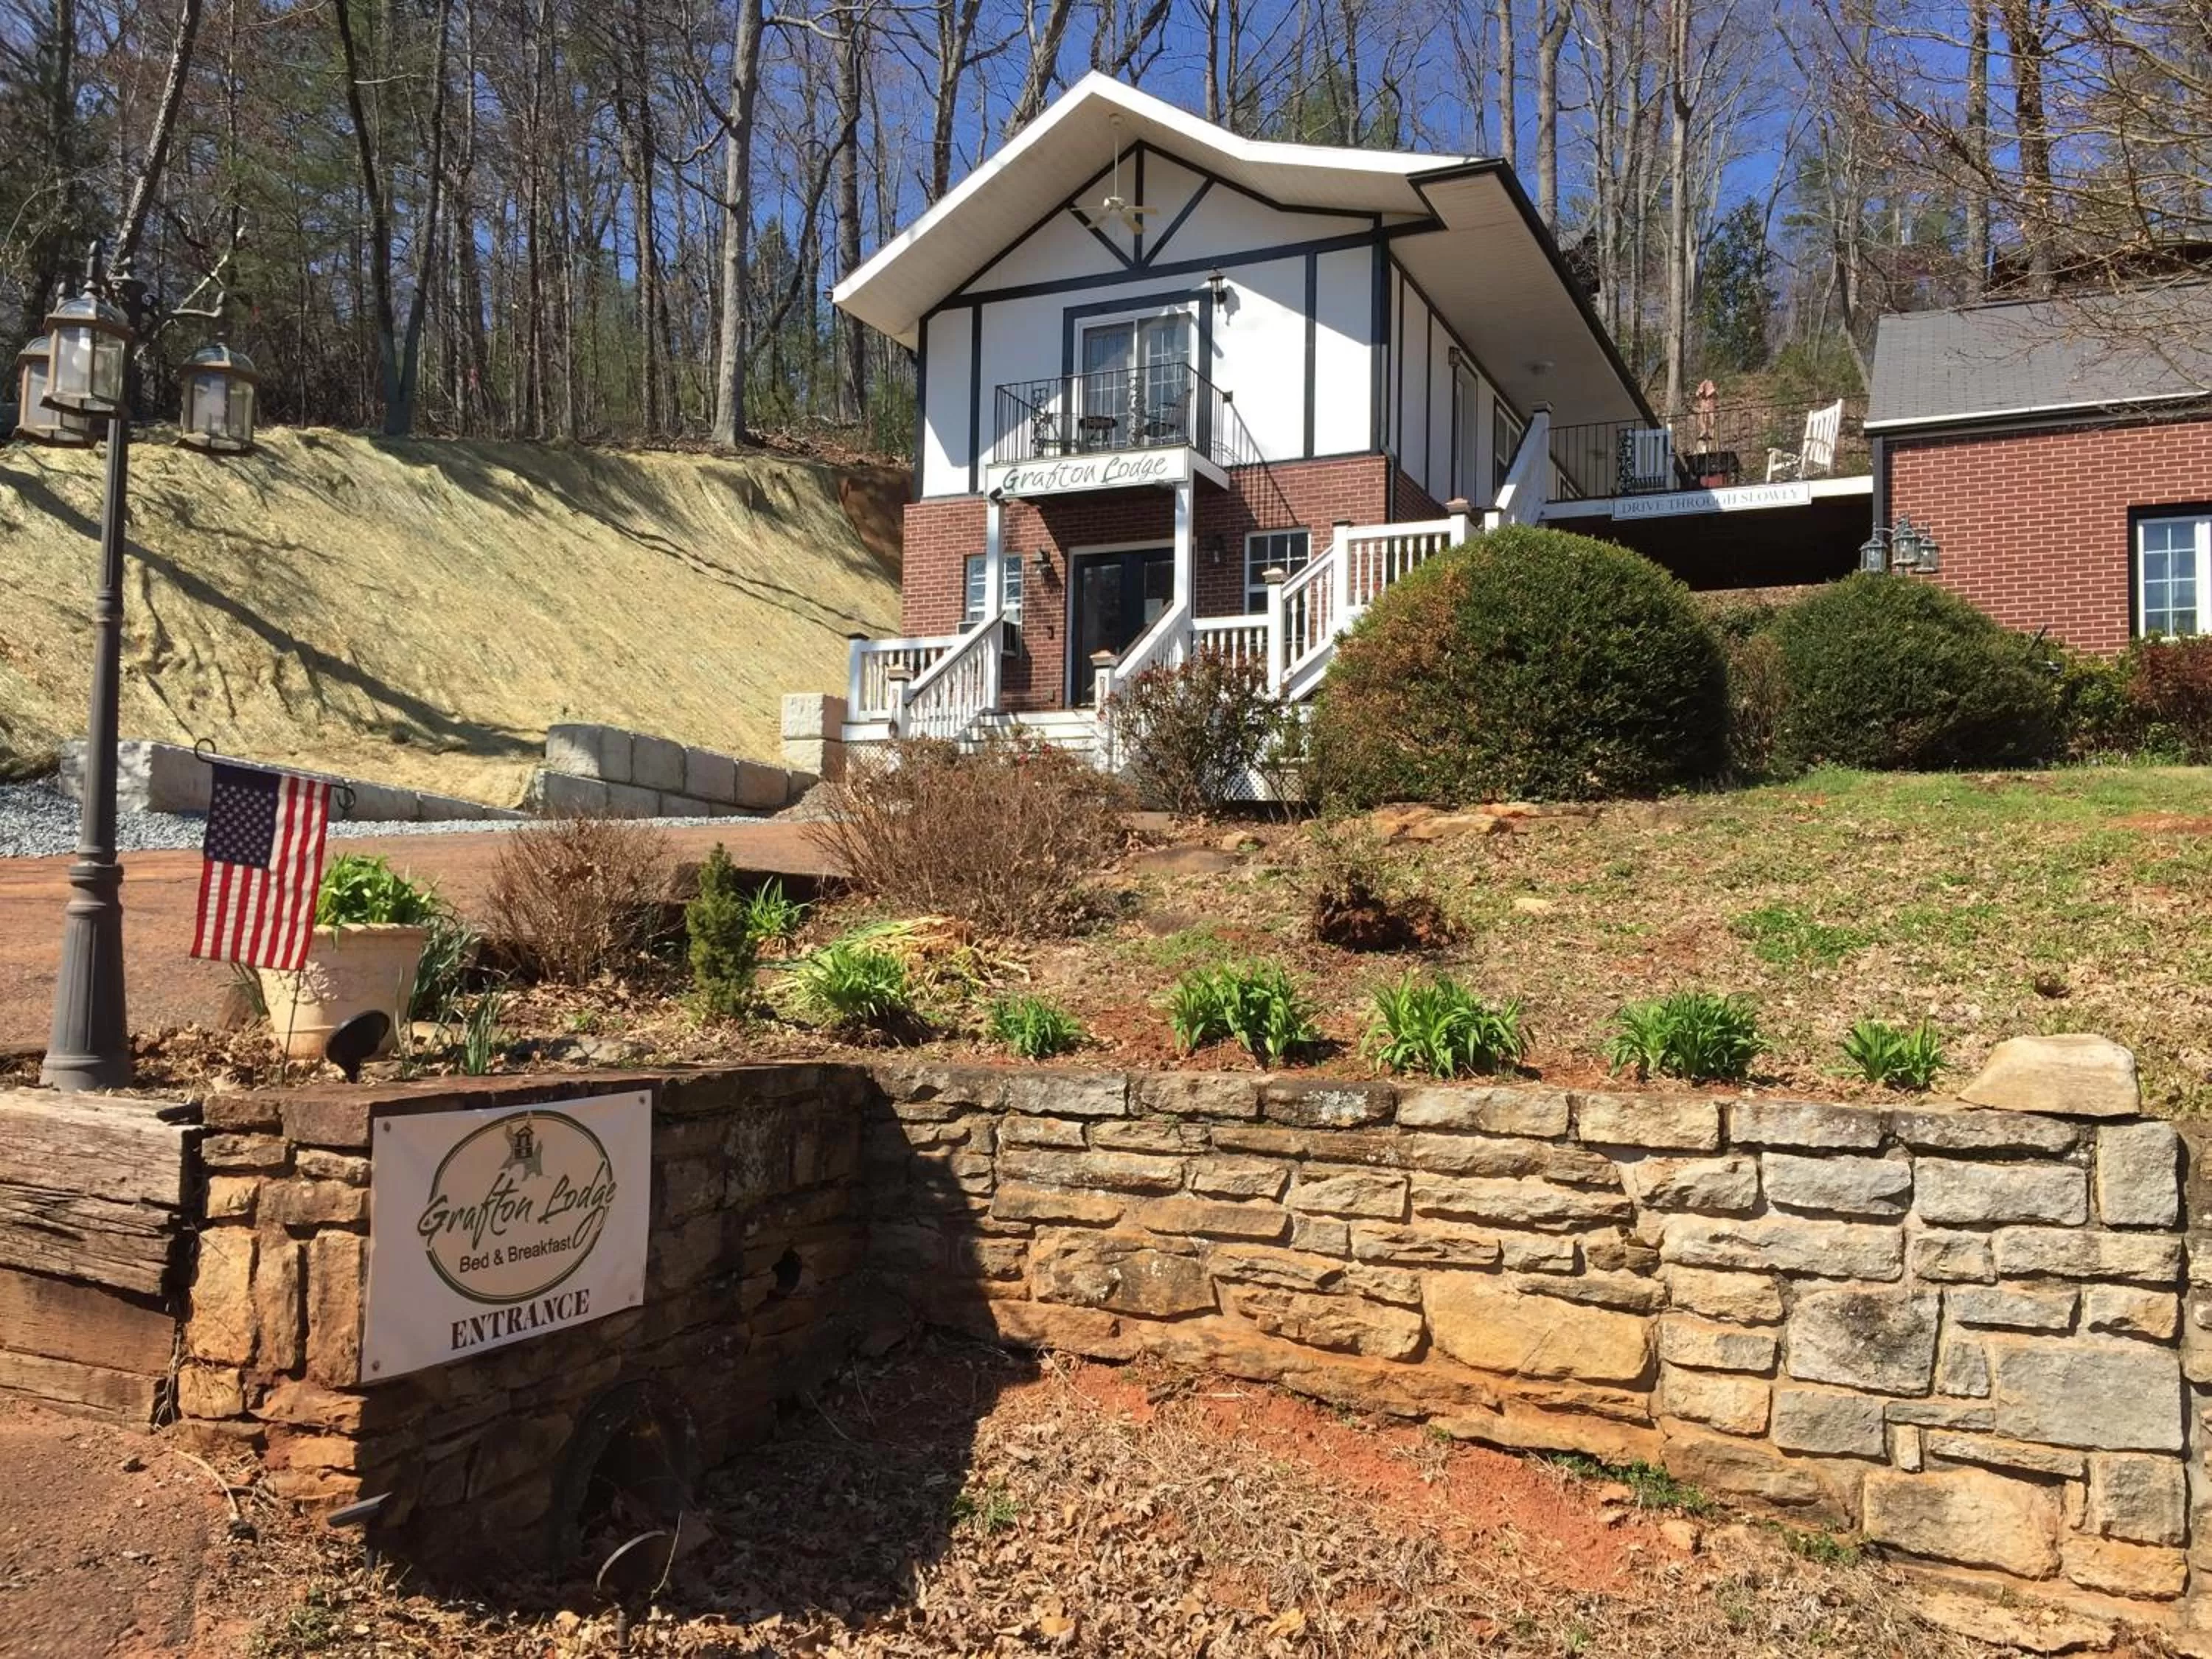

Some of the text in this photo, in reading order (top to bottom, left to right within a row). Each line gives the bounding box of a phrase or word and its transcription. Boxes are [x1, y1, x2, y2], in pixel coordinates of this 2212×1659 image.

[1002, 455, 1168, 491] Grafton Lodge
[1622, 487, 1800, 513] DRIVE THROUGH SLOWLY
[417, 1160, 617, 1251] Grafton Lodge
[459, 1234, 574, 1273] Bed & Breakfast
[450, 1289, 590, 1351] ENTRANCE
